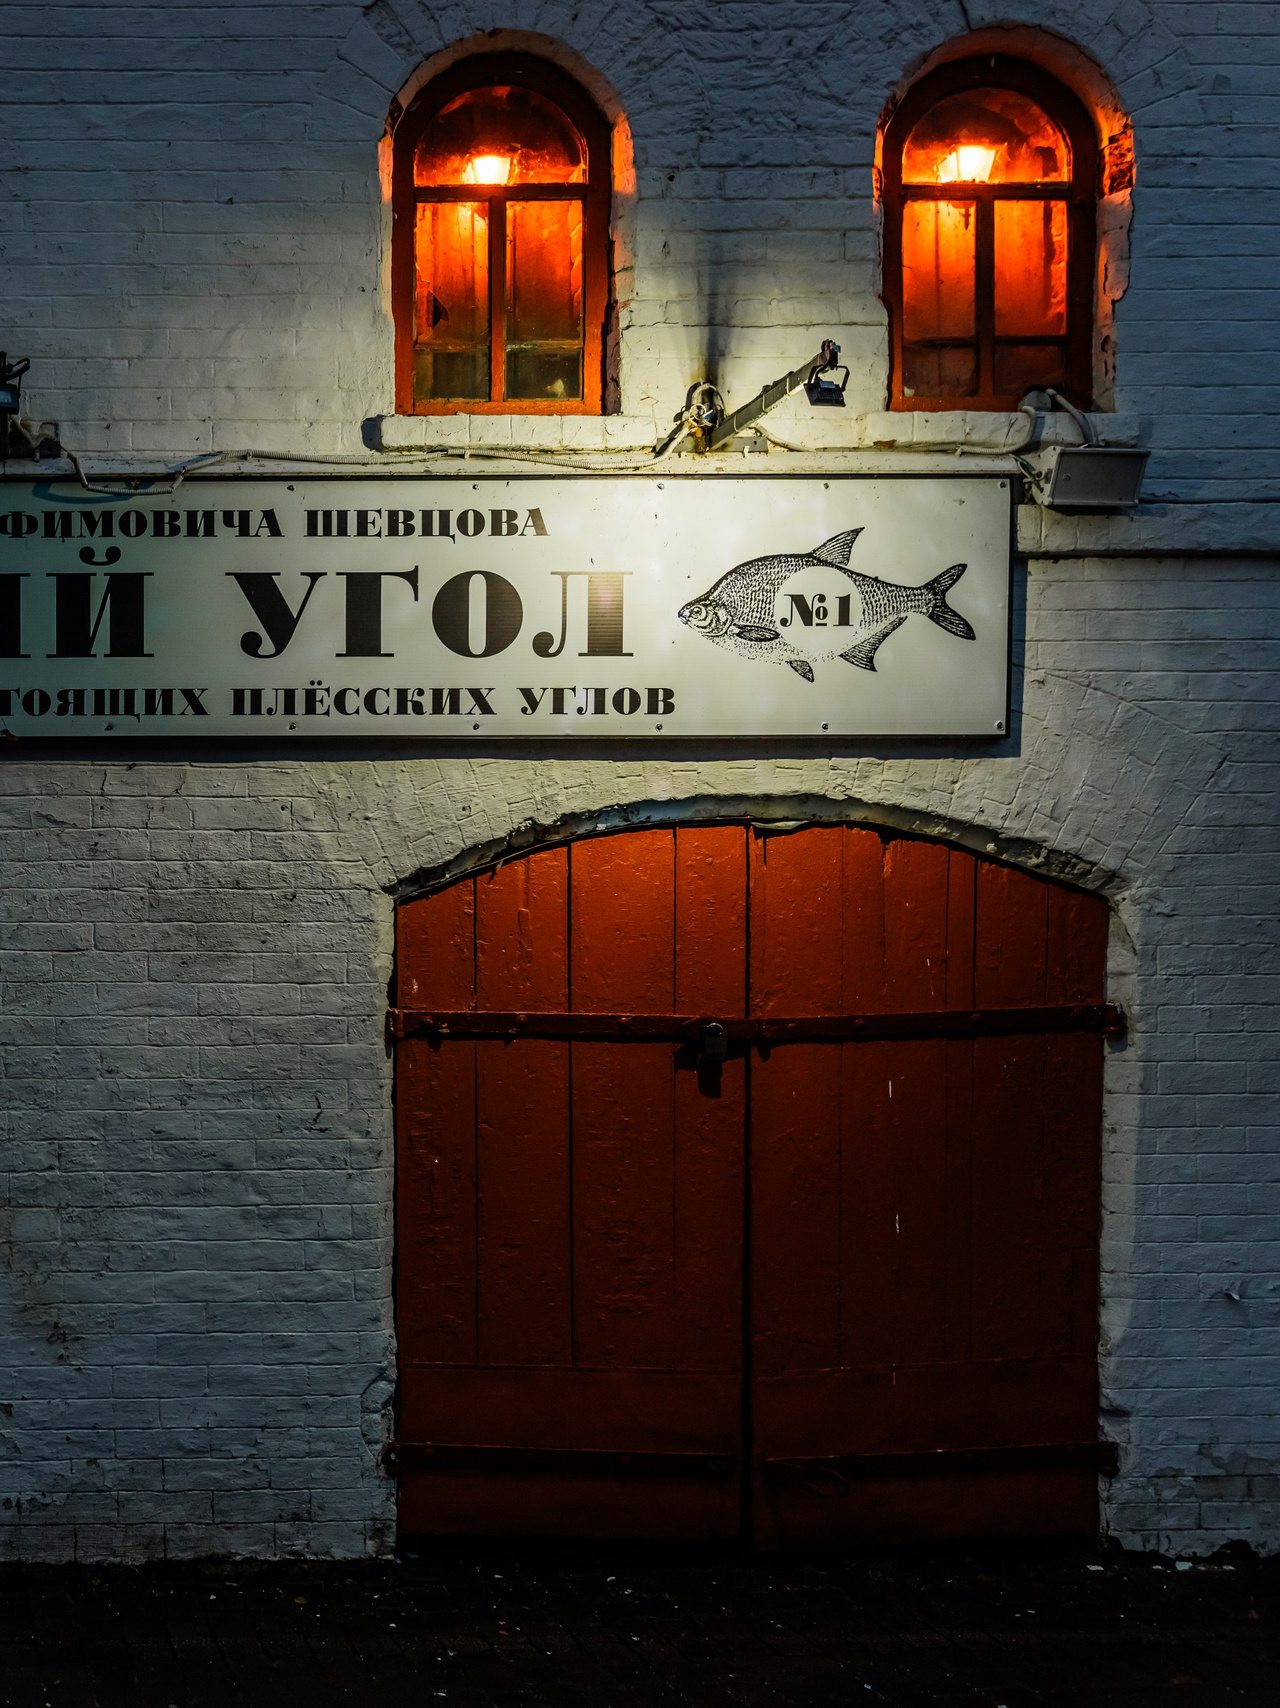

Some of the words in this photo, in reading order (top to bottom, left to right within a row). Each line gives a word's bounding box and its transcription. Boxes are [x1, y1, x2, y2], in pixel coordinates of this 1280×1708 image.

[303, 507, 551, 545] ШЕВЦОВА
[224, 565, 635, 660] УГОЛ
[779, 592, 855, 628] №1
[229, 680, 497, 717] ПЛЁССКИХ
[517, 686, 676, 717] УГЛОВ
